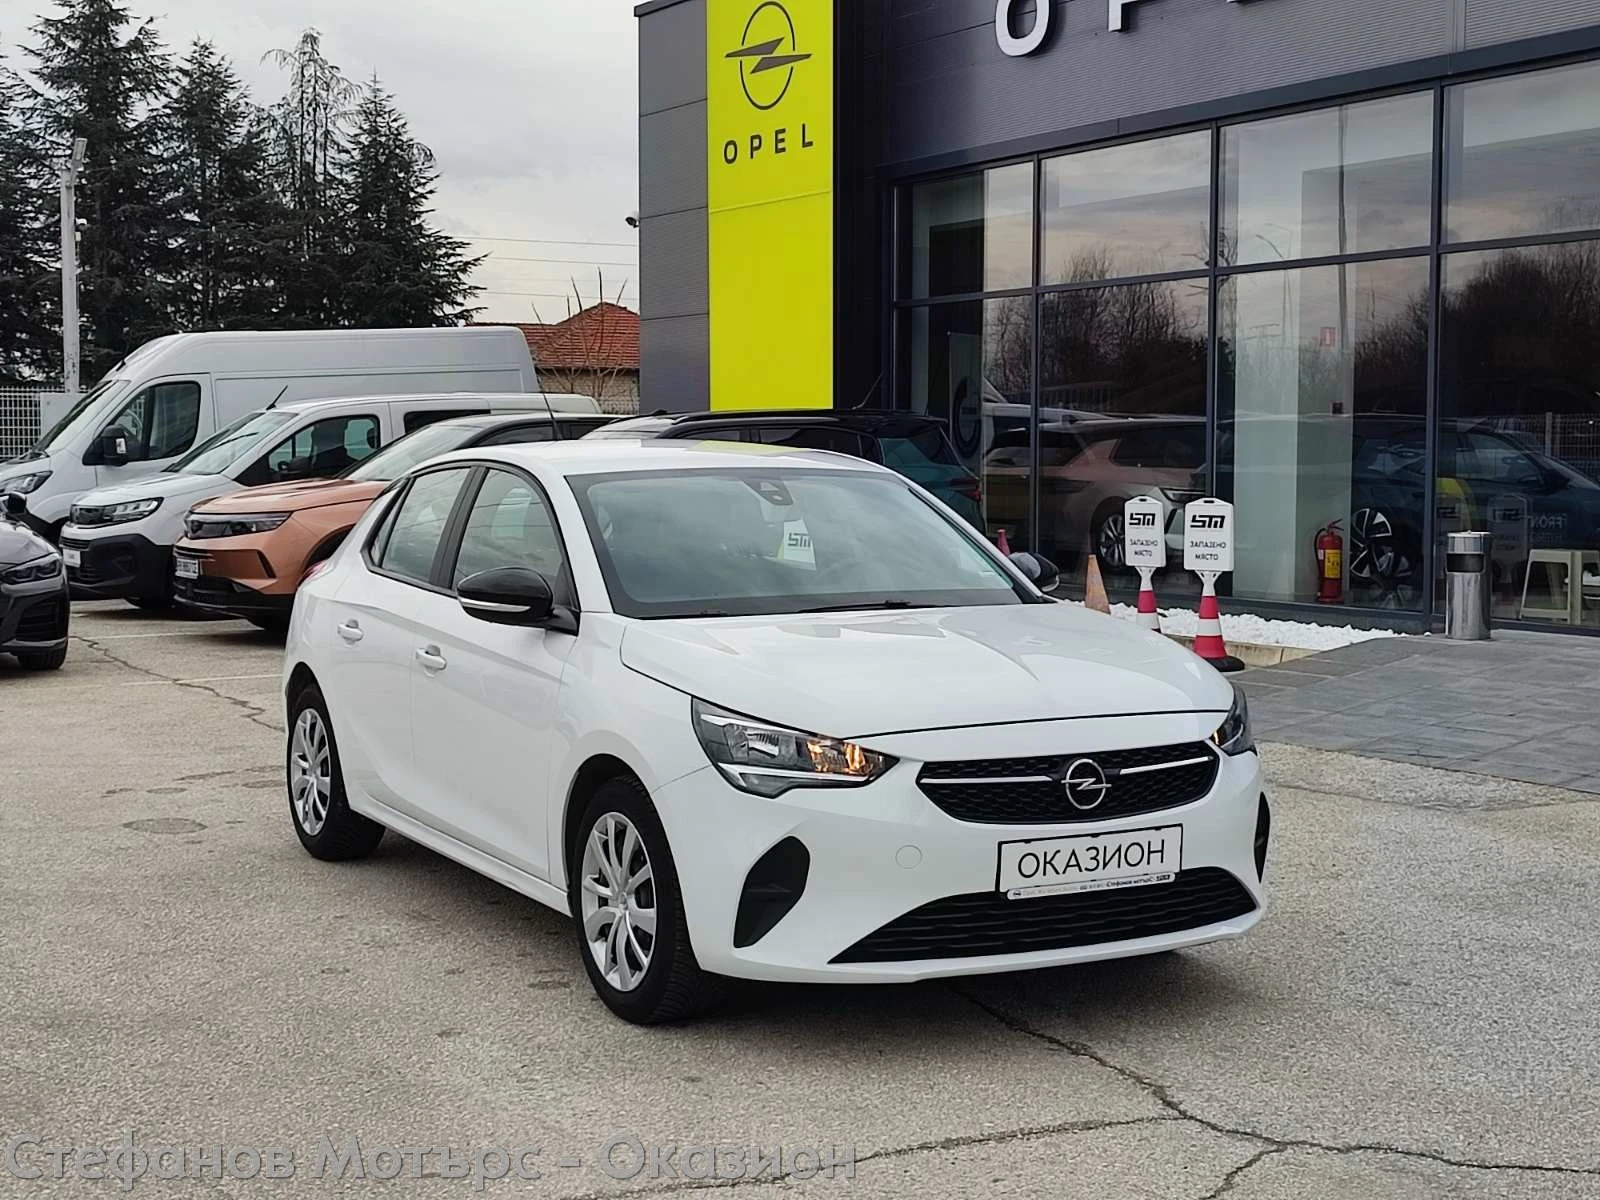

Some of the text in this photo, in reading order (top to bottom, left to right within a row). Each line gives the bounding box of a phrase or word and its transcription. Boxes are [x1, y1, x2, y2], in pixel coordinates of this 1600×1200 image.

[723, 122, 814, 165] OPEL
[1189, 540, 1227, 549] ЗАПАЗЕНО
[1195, 552, 1219, 561] МЯСТО
[1018, 839, 1165, 878] ОКАЗИОН
